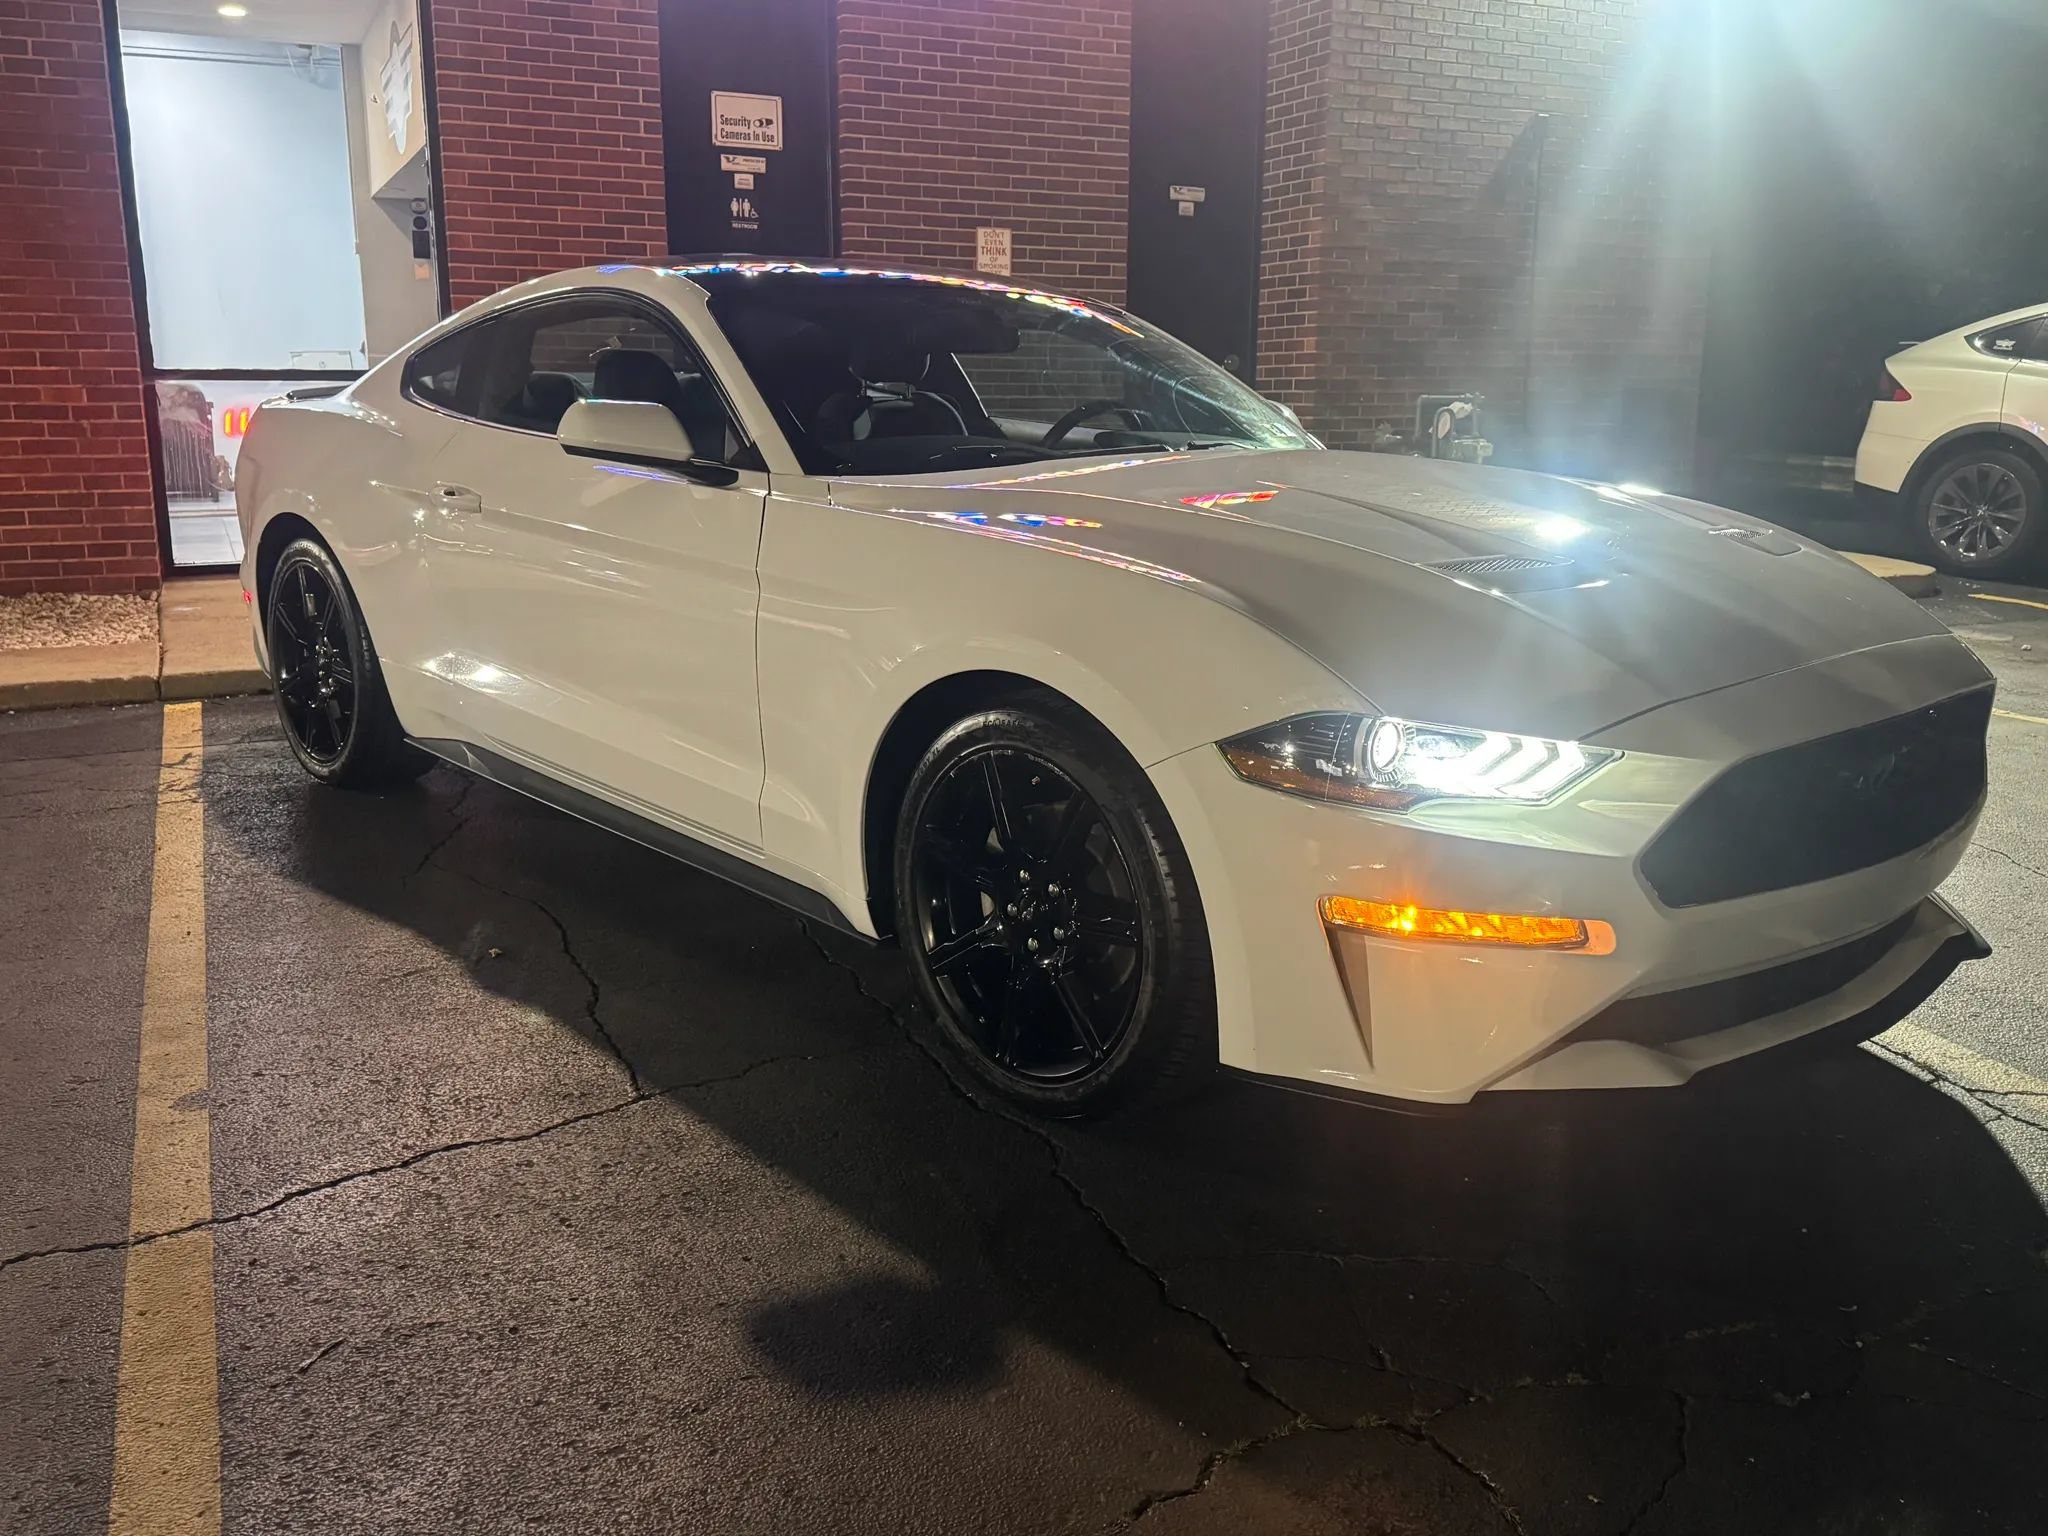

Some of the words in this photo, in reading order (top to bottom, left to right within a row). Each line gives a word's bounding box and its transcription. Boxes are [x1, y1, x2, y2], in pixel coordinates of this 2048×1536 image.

[720, 114, 751, 129] Security
[720, 128, 751, 141] Cameras
[753, 130, 760, 142] In
[762, 131, 775, 143] Use
[981, 246, 1007, 257] THINK
